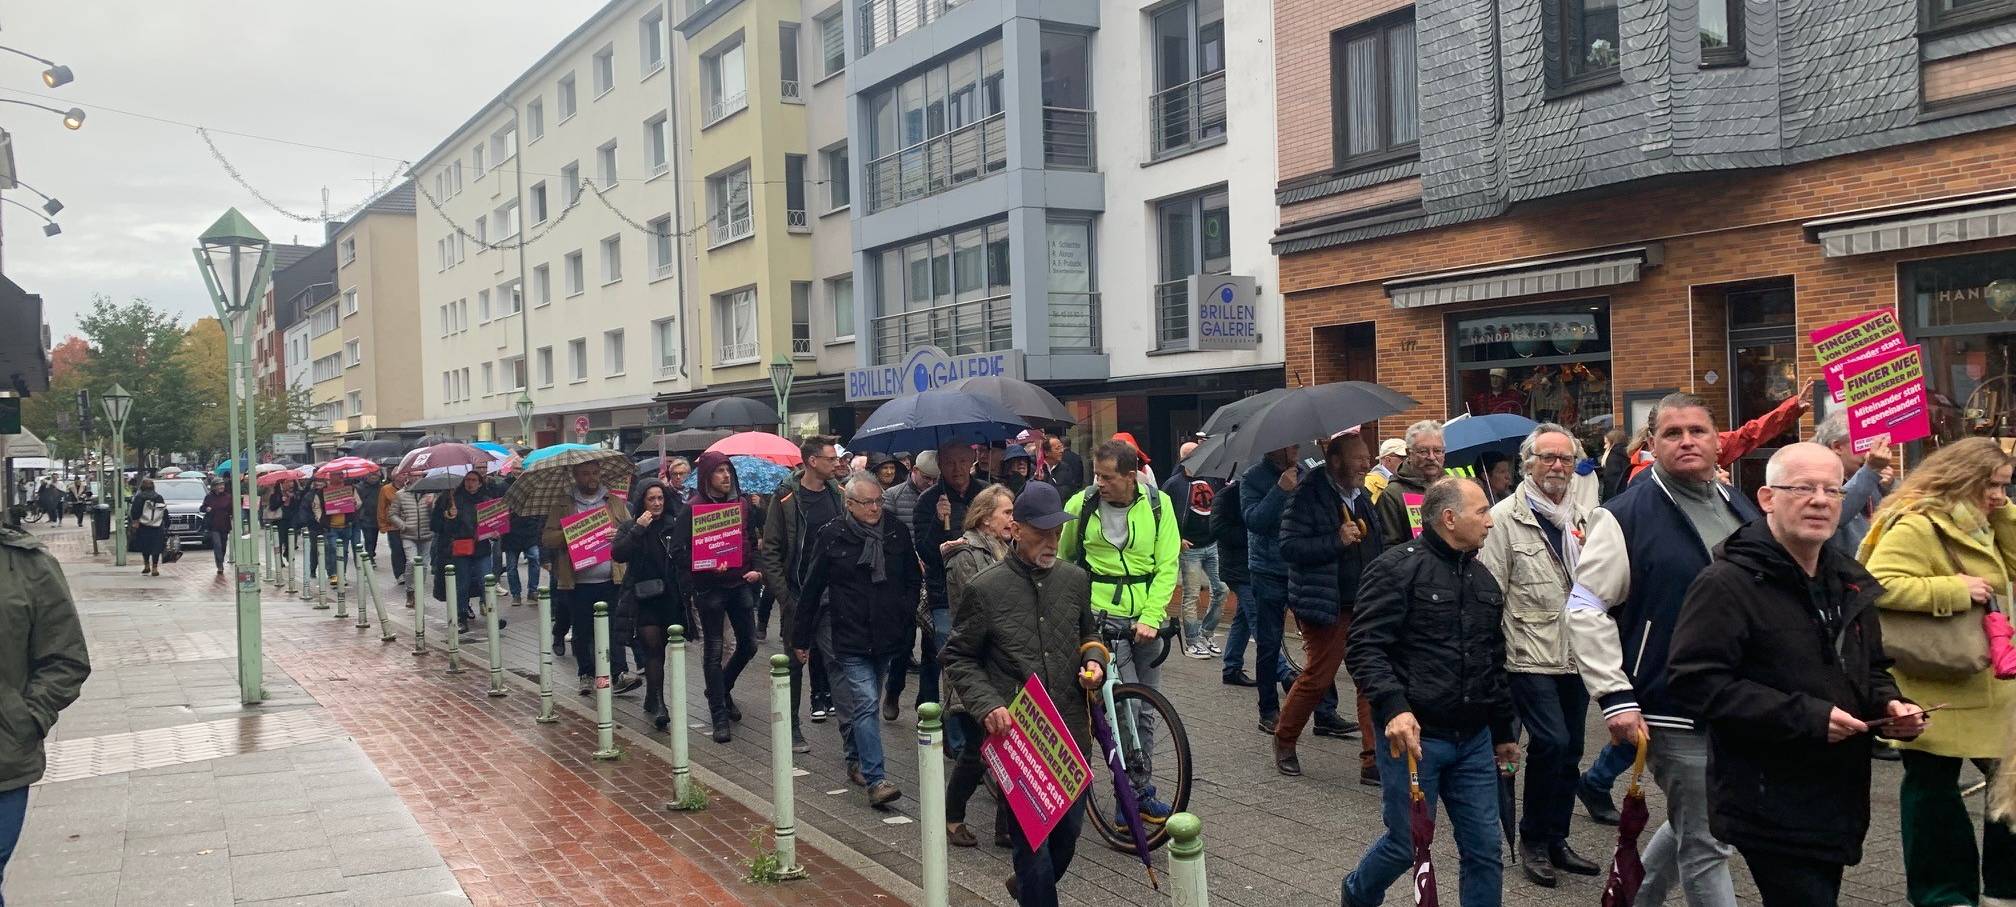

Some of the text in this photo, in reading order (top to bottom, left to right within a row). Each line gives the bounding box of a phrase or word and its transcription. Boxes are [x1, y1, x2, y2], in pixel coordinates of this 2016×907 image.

[1200, 304, 1254, 320] BRILLEN
[1201, 321, 1254, 336] GALERIE
[1818, 314, 1892, 353] FINGER WEG
[1823, 325, 1896, 362] VON UNSERER RÜ!
[1880, 338, 1901, 352] statt
[850, 367, 904, 398] BRILLEN
[1848, 354, 1918, 391] FINGER WEG
[1850, 390, 1869, 402] VON
[1870, 374, 1905, 393] UNSERER
[1906, 367, 1920, 380] RÜ!
[1854, 392, 1902, 418] Miteinander
[1903, 384, 1922, 397] statt
[1862, 396, 1921, 428] gegeneinander!
[694, 508, 740, 526] FINGER WEG
[1014, 707, 1076, 796] VON UNSERER RÜ!
[1020, 694, 1084, 784] FINGER WEG
[1003, 740, 1056, 815] gegeneinander!
[1046, 782, 1065, 809] statt
